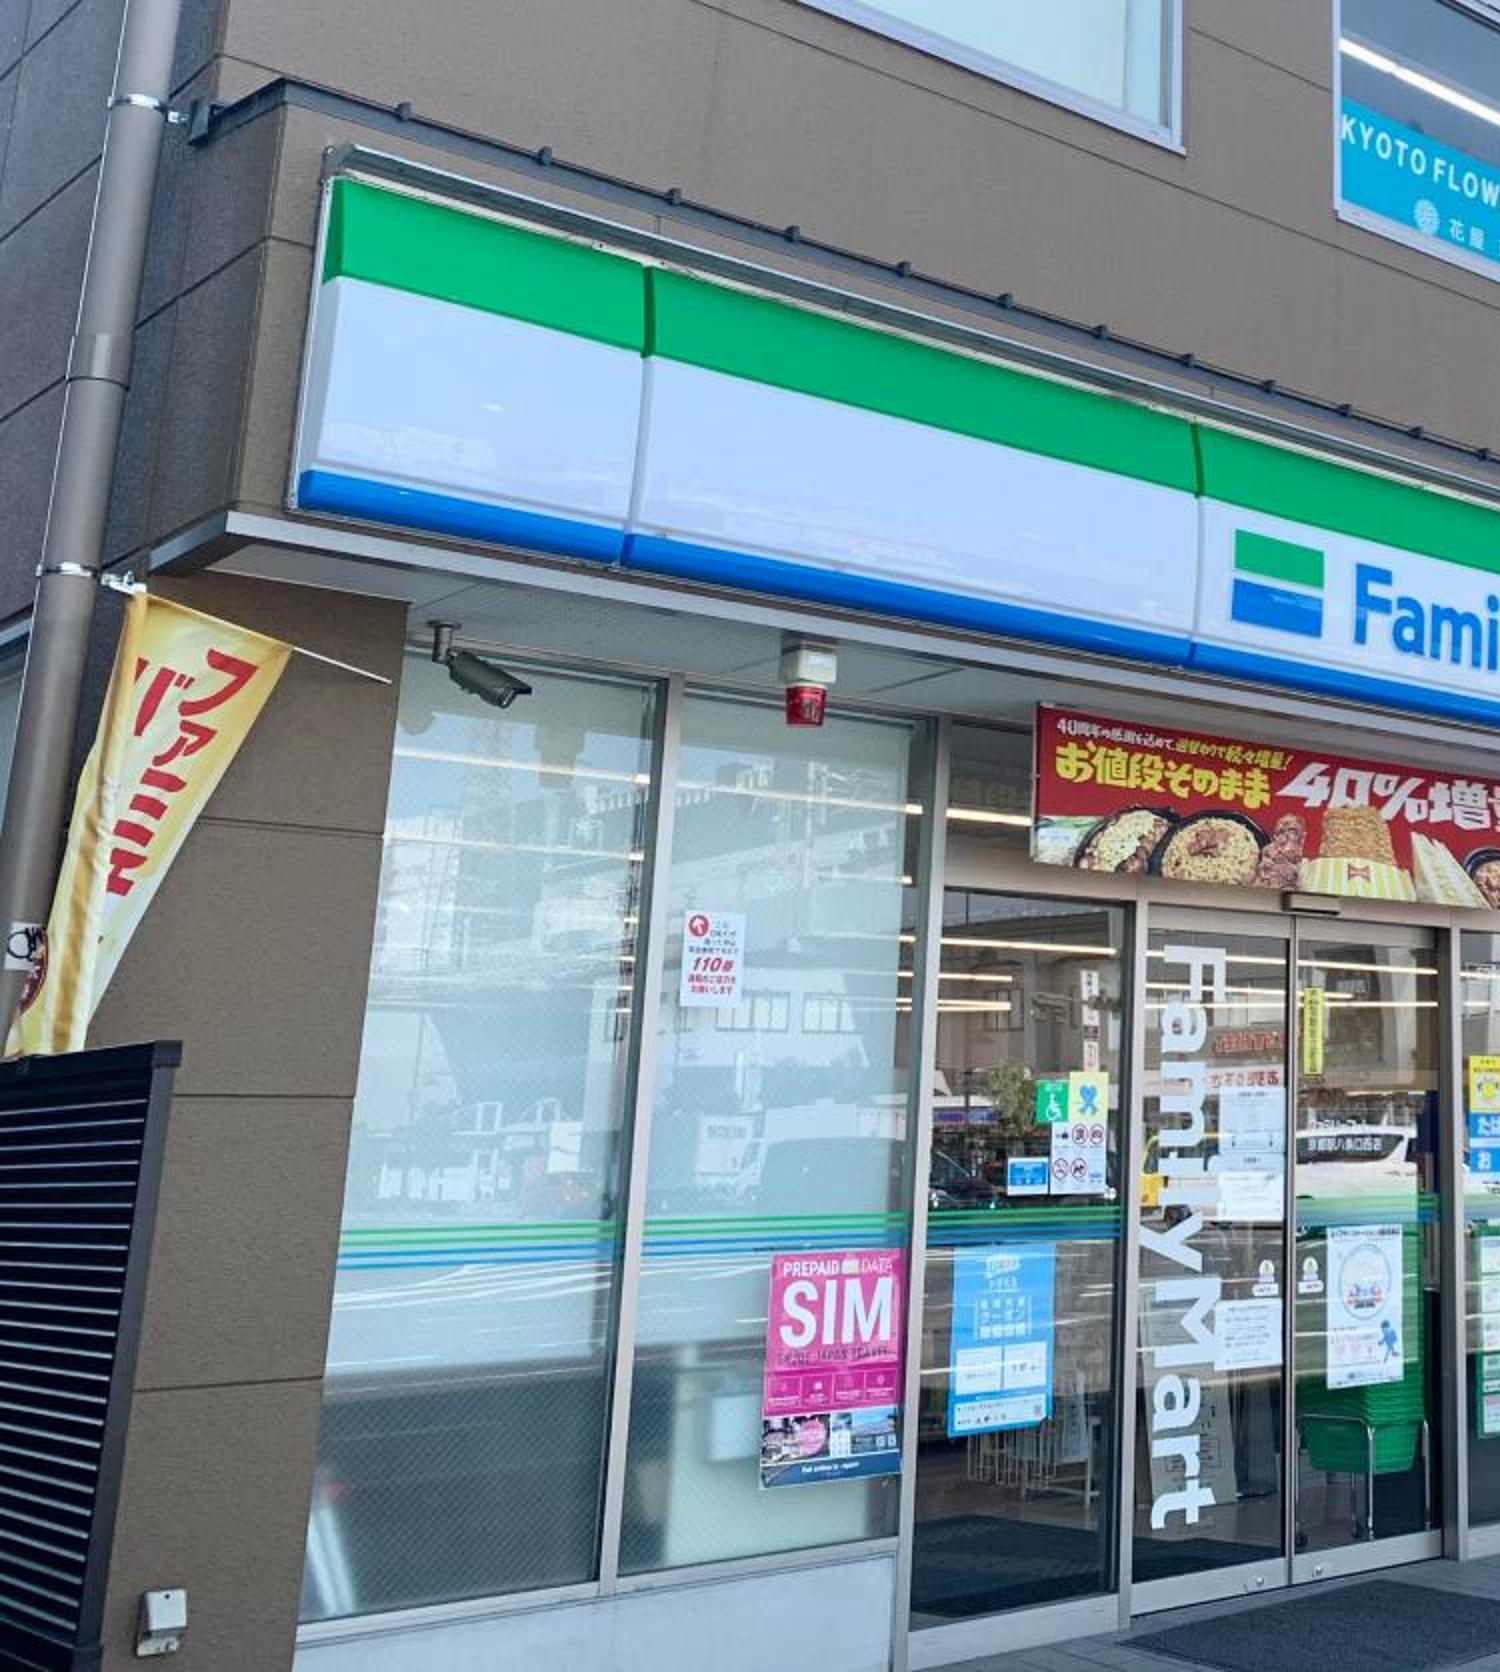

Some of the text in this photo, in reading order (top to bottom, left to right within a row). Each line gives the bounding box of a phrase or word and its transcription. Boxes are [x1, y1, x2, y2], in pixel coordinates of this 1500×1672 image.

[1341, 111, 1427, 177] KYOTO
[1448, 216, 1487, 252] 花屋
[1055, 740, 1272, 809] お値段そのまま
[782, 1258, 840, 1277] PREPAID
[1138, 944, 1227, 1530] FamilyMart
[778, 1276, 894, 1348] SIM
